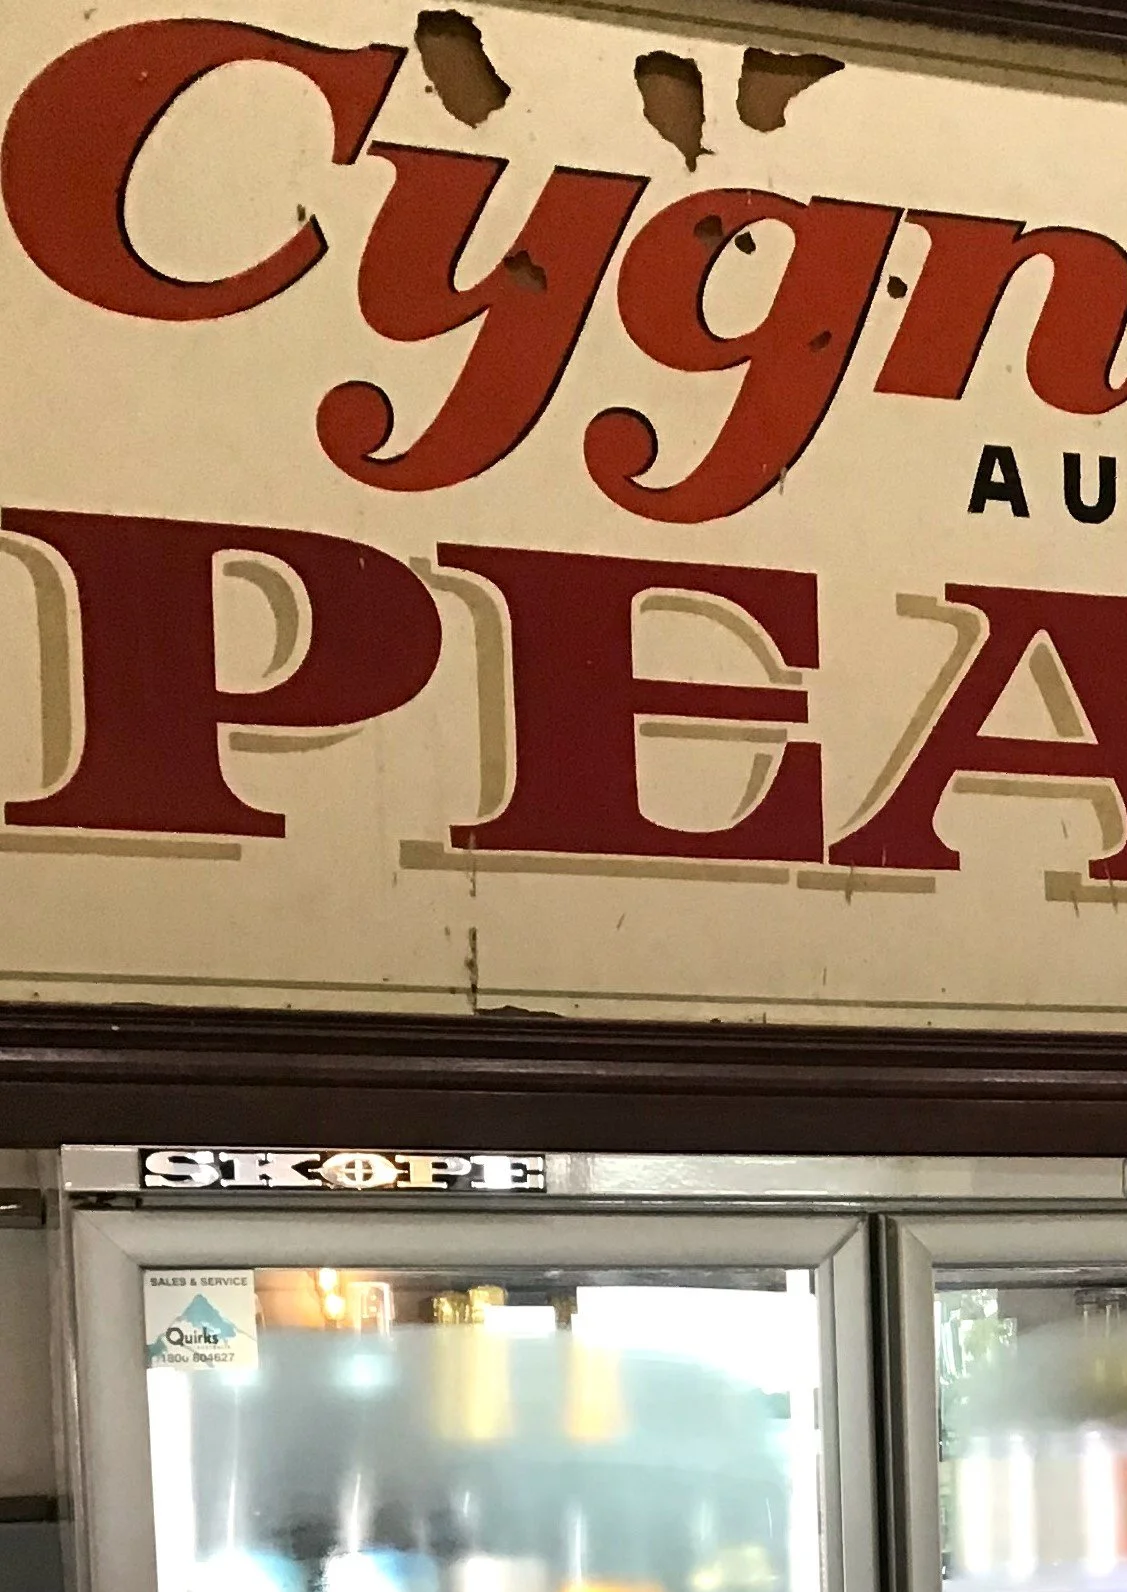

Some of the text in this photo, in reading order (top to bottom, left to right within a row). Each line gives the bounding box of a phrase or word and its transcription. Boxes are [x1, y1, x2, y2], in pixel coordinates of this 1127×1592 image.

[144, 1150, 545, 1191] SKOPE
[150, 1276, 248, 1287] SALES & SERVICE
[165, 1326, 219, 1346] Quirks
